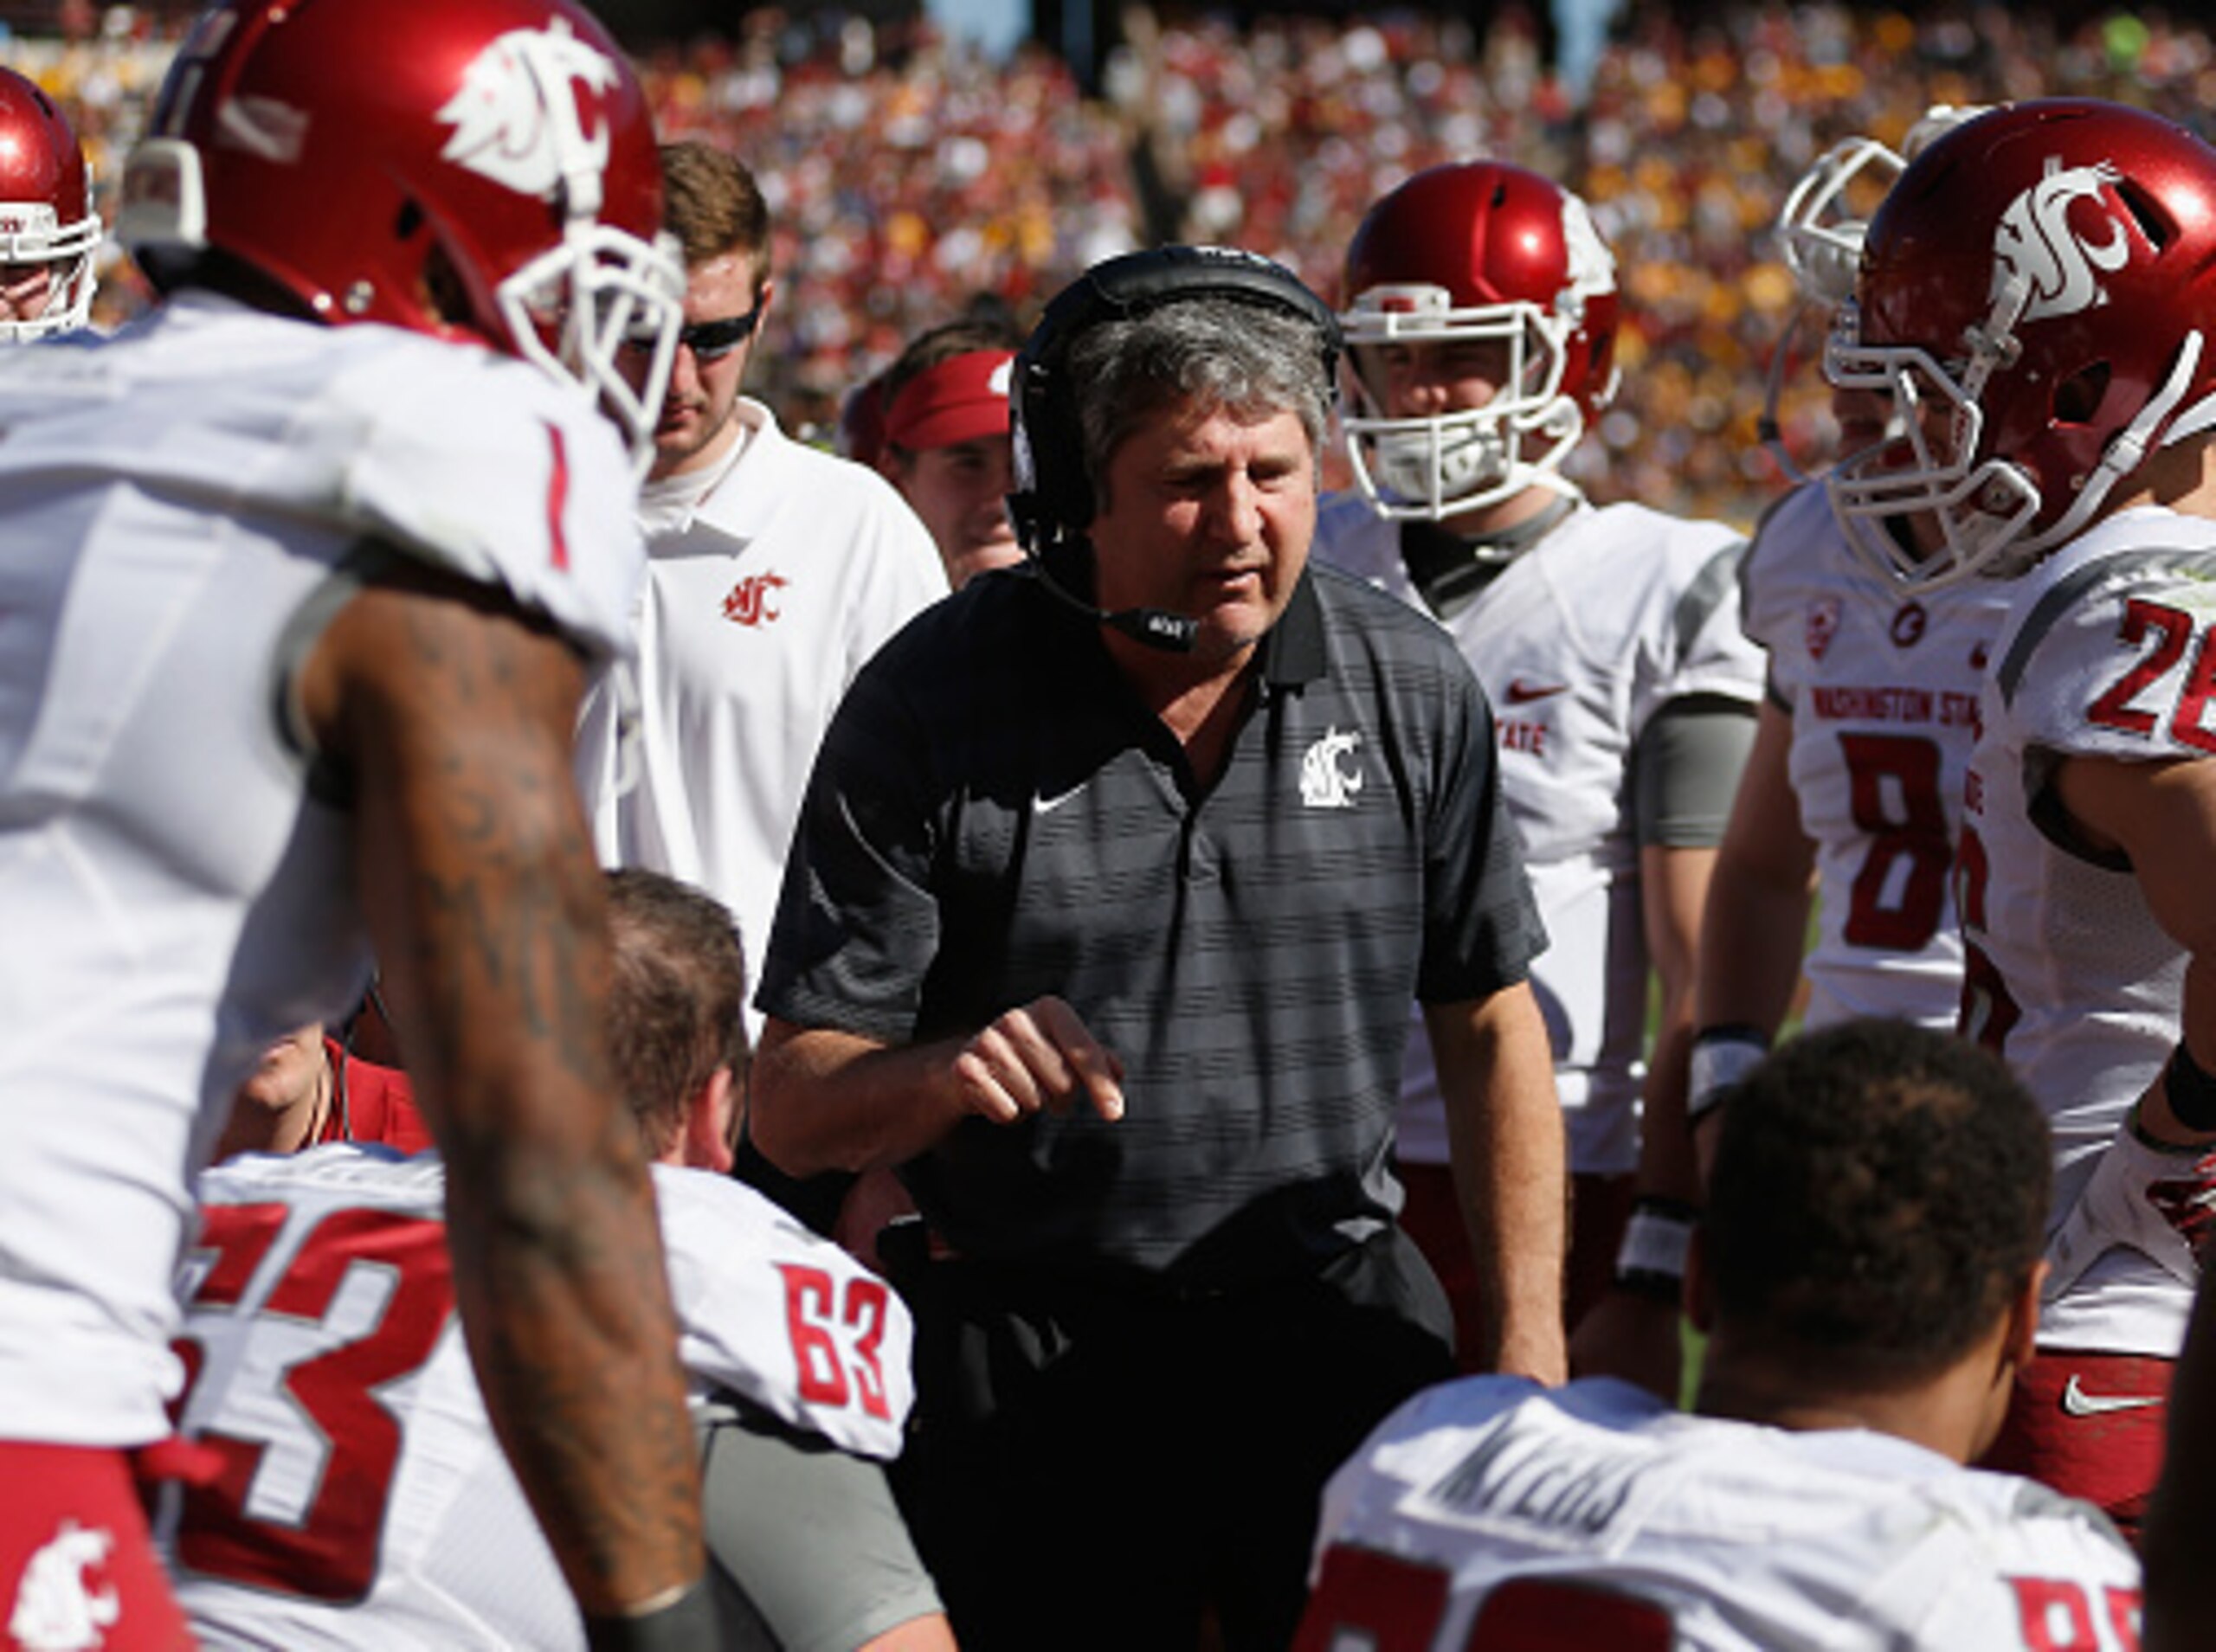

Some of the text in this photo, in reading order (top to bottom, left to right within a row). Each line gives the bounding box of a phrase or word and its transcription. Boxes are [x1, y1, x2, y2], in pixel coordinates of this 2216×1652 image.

[1811, 687, 1933, 723] WASHINGTON
[1836, 730, 1953, 952] 8
[770, 1261, 893, 1422] 63
